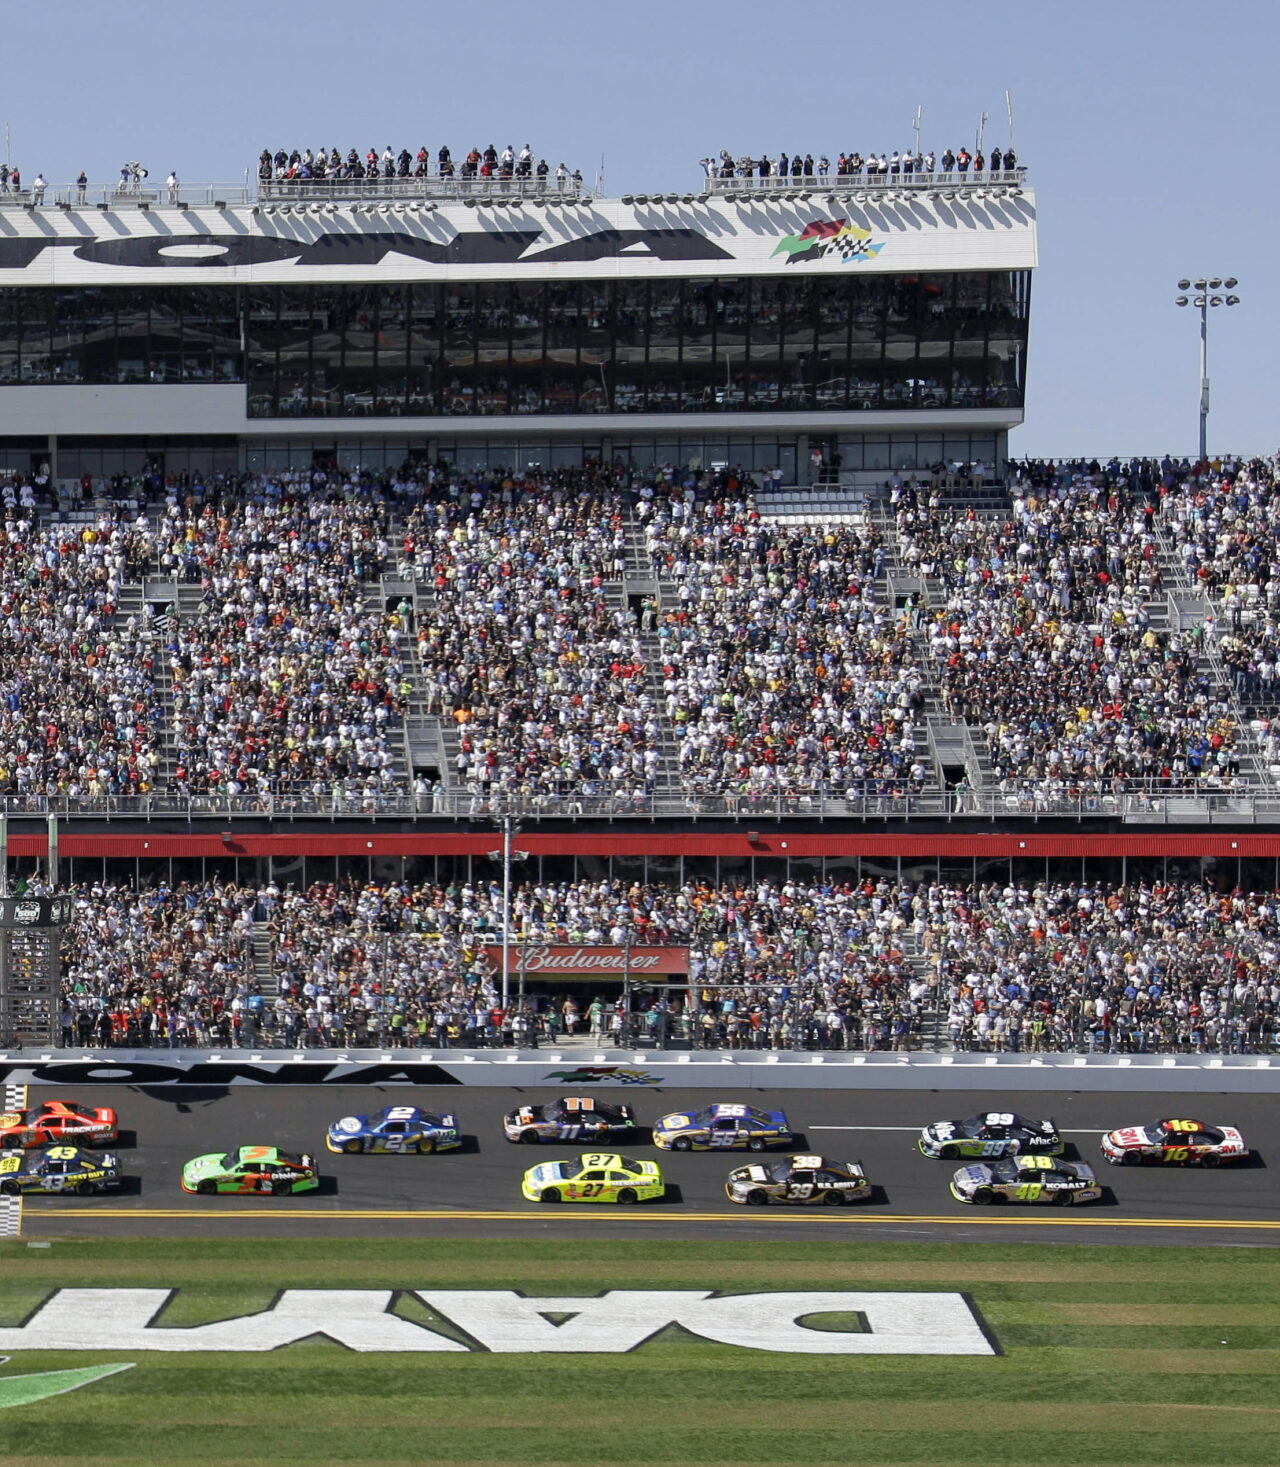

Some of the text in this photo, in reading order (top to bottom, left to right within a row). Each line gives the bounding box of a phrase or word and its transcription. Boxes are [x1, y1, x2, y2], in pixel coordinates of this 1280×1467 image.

[563, 1097, 594, 1110] 11
[387, 1106, 416, 1119] 2
[717, 1104, 746, 1117] 56
[985, 1112, 1015, 1125] 99
[61, 1125, 105, 1134] TRACKER
[560, 1124, 581, 1139] 11
[1169, 1119, 1199, 1132] 16
[385, 1134, 403, 1149] 2
[709, 1131, 737, 1146] 56
[1029, 1136, 1052, 1146] Aflac
[1120, 1128, 1140, 1144] 3M
[46, 1146, 78, 1159] 43
[982, 1142, 1004, 1155] 99
[1163, 1147, 1189, 1161] 16
[1218, 1145, 1237, 1154] 3M
[588, 1154, 615, 1166] 27
[792, 1155, 822, 1168] 39
[1020, 1155, 1054, 1168] 48
[86, 1170, 106, 1179] BUY
[40, 1176, 65, 1190] 43
[1045, 1182, 1086, 1190] KOBALT
[582, 1183, 604, 1197] 27
[787, 1183, 814, 1199] 39
[1015, 1183, 1042, 1200] 48
